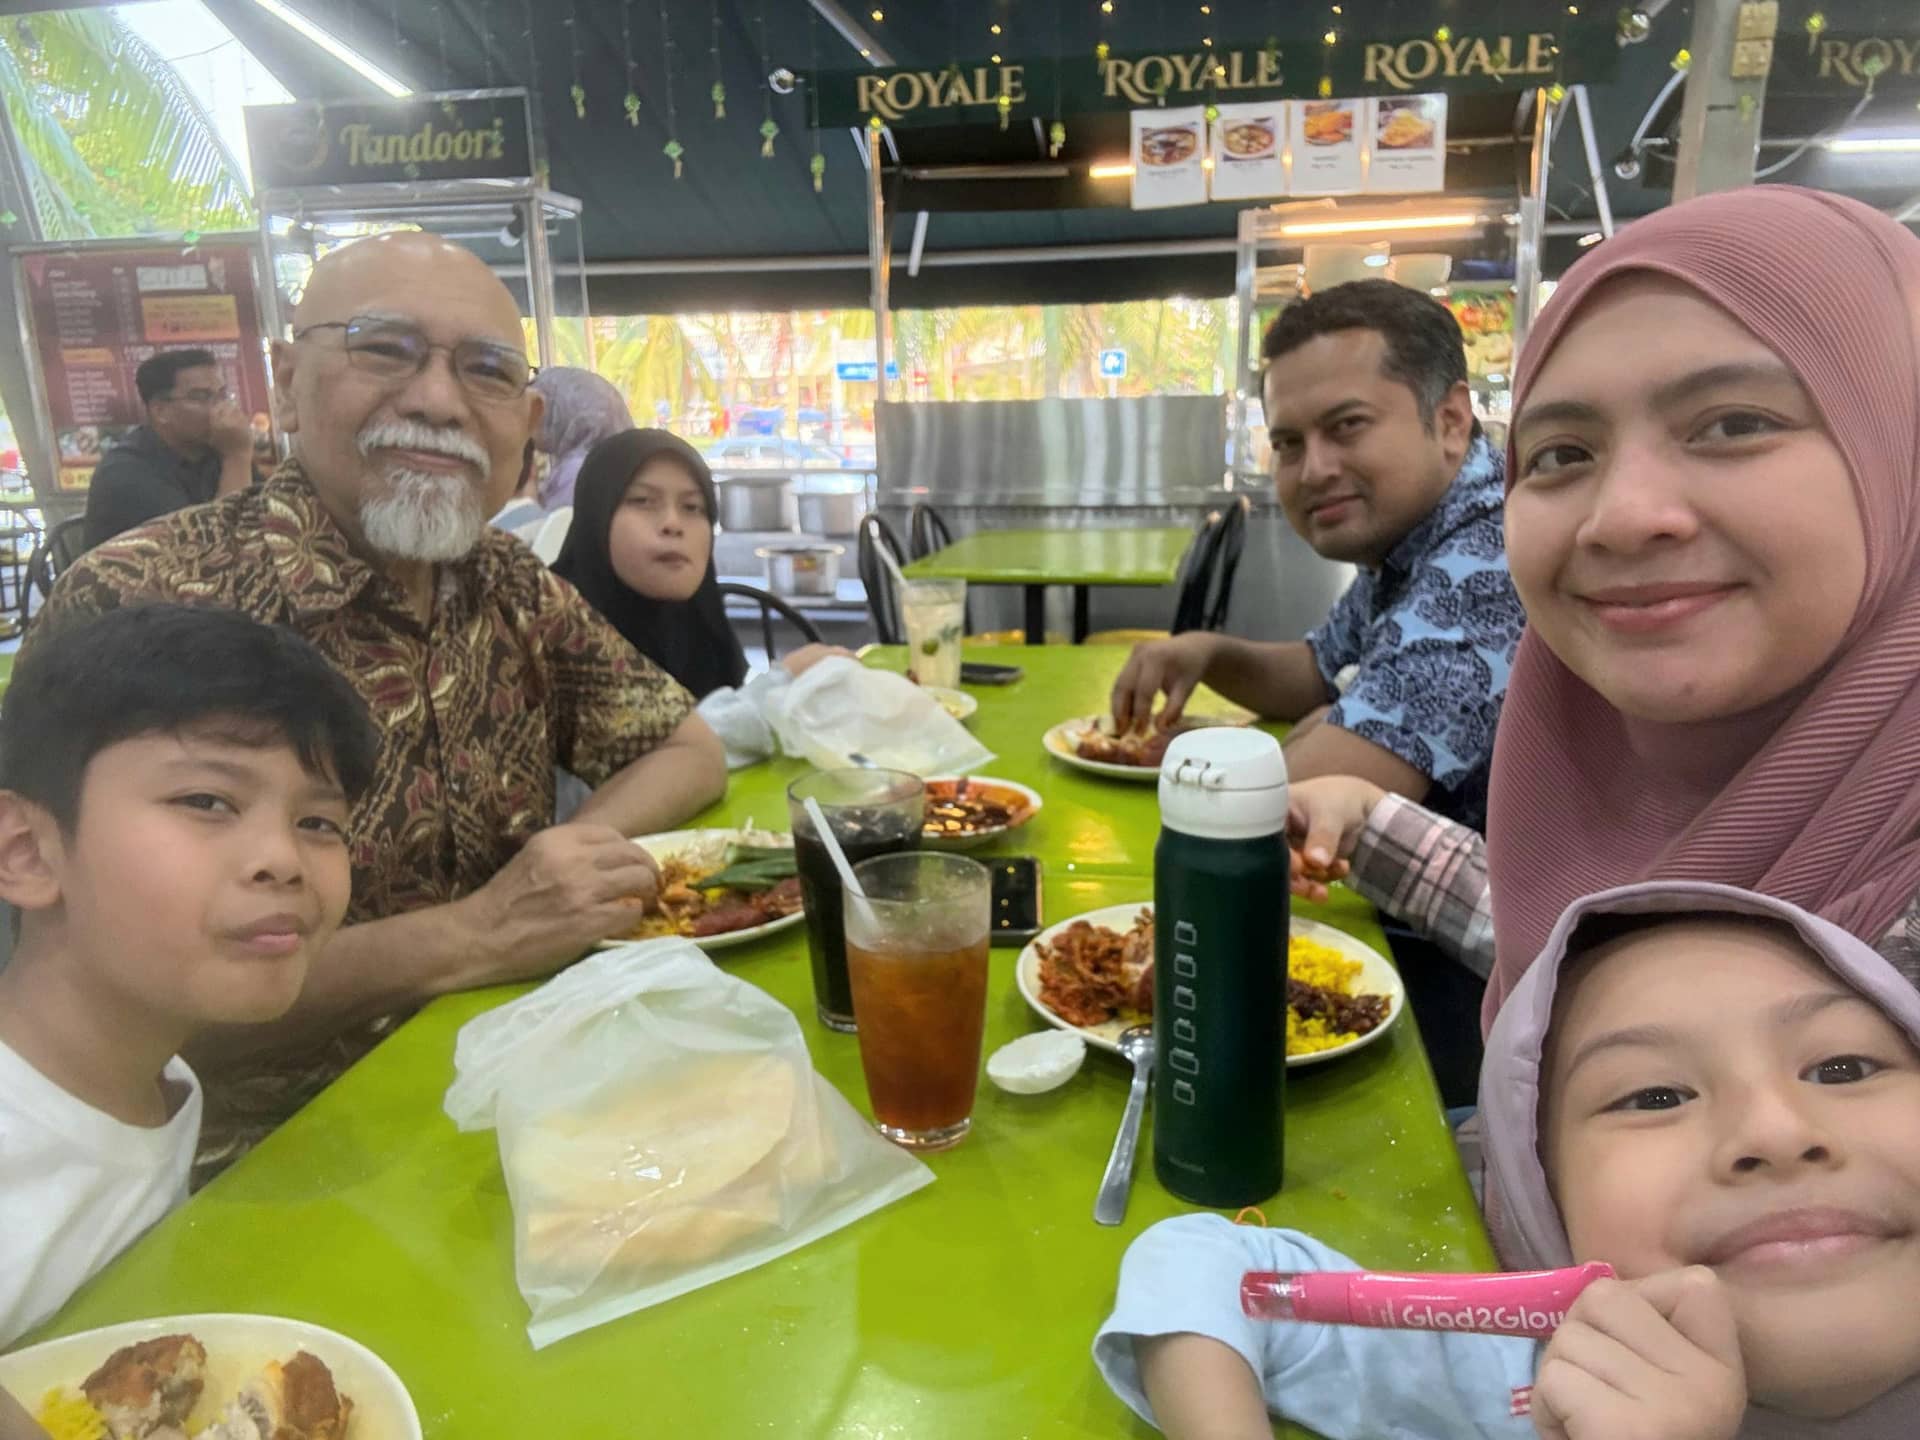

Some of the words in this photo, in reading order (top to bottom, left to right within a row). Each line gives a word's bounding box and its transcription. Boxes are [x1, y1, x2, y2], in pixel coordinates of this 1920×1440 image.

[856, 66, 1027, 120] ROYALE
[1103, 50, 1284, 105] ROYALE
[1363, 32, 1555, 89] ROYALE
[1818, 37, 1920, 87] ROY
[339, 117, 505, 167] Tandoori
